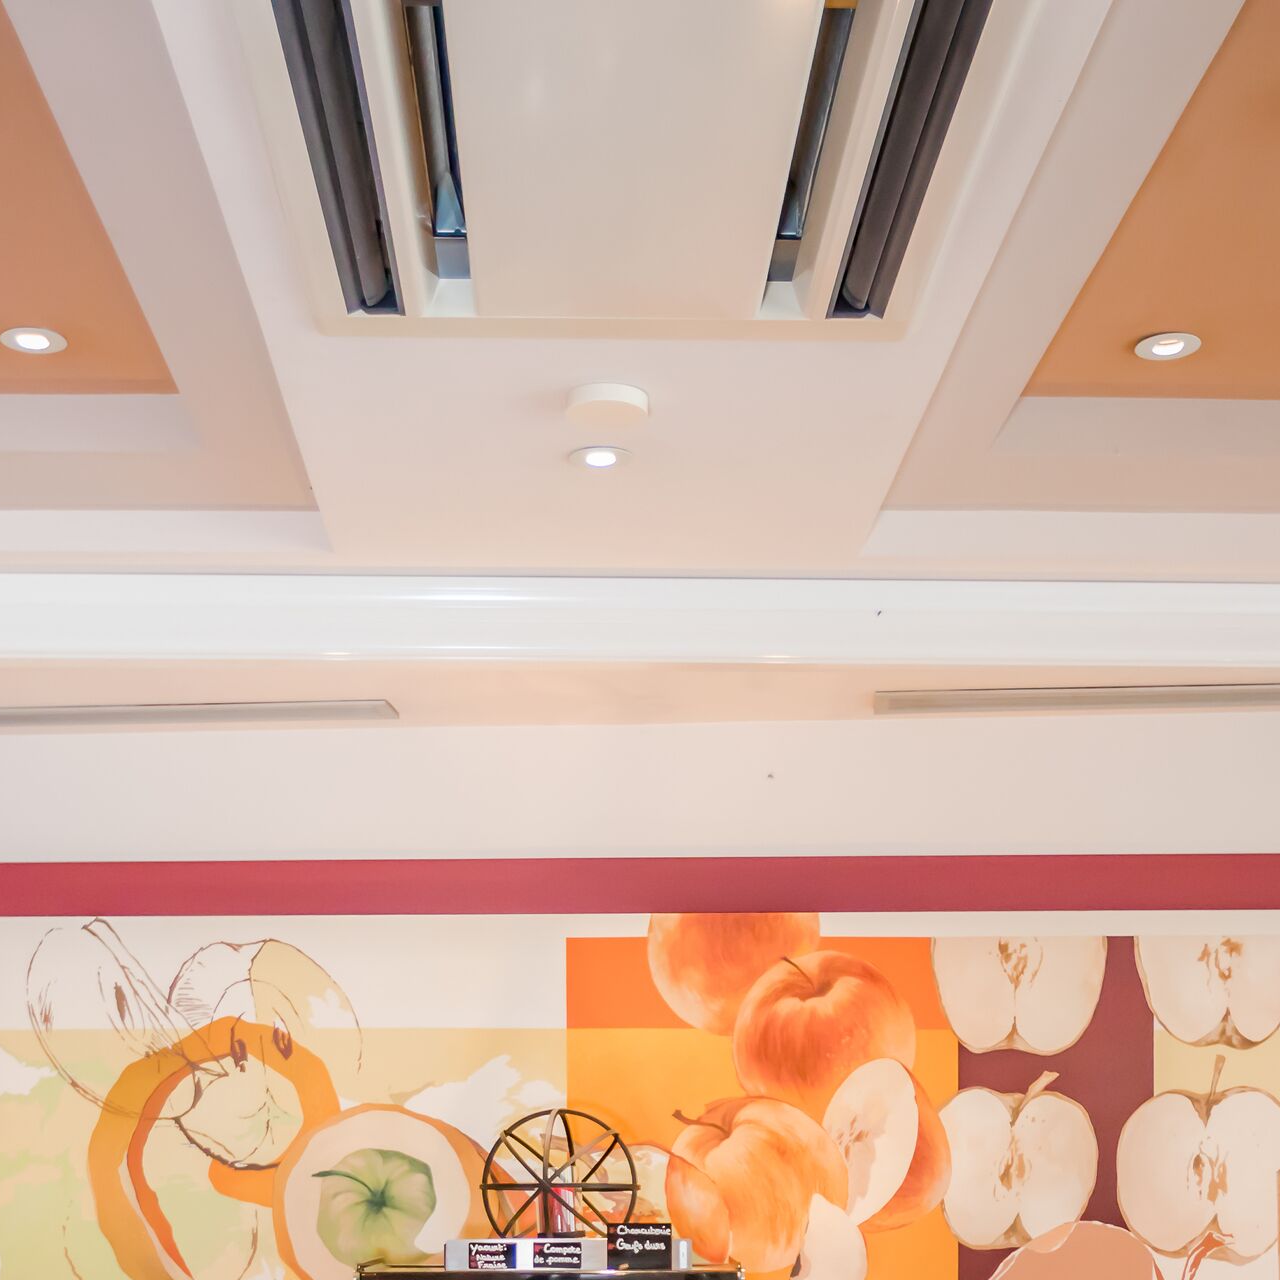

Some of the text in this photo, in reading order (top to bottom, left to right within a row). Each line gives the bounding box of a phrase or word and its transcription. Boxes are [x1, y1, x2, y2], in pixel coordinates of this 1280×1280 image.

[543, 1243, 581, 1255] Compote
[534, 1255, 579, 1265] de pomme
